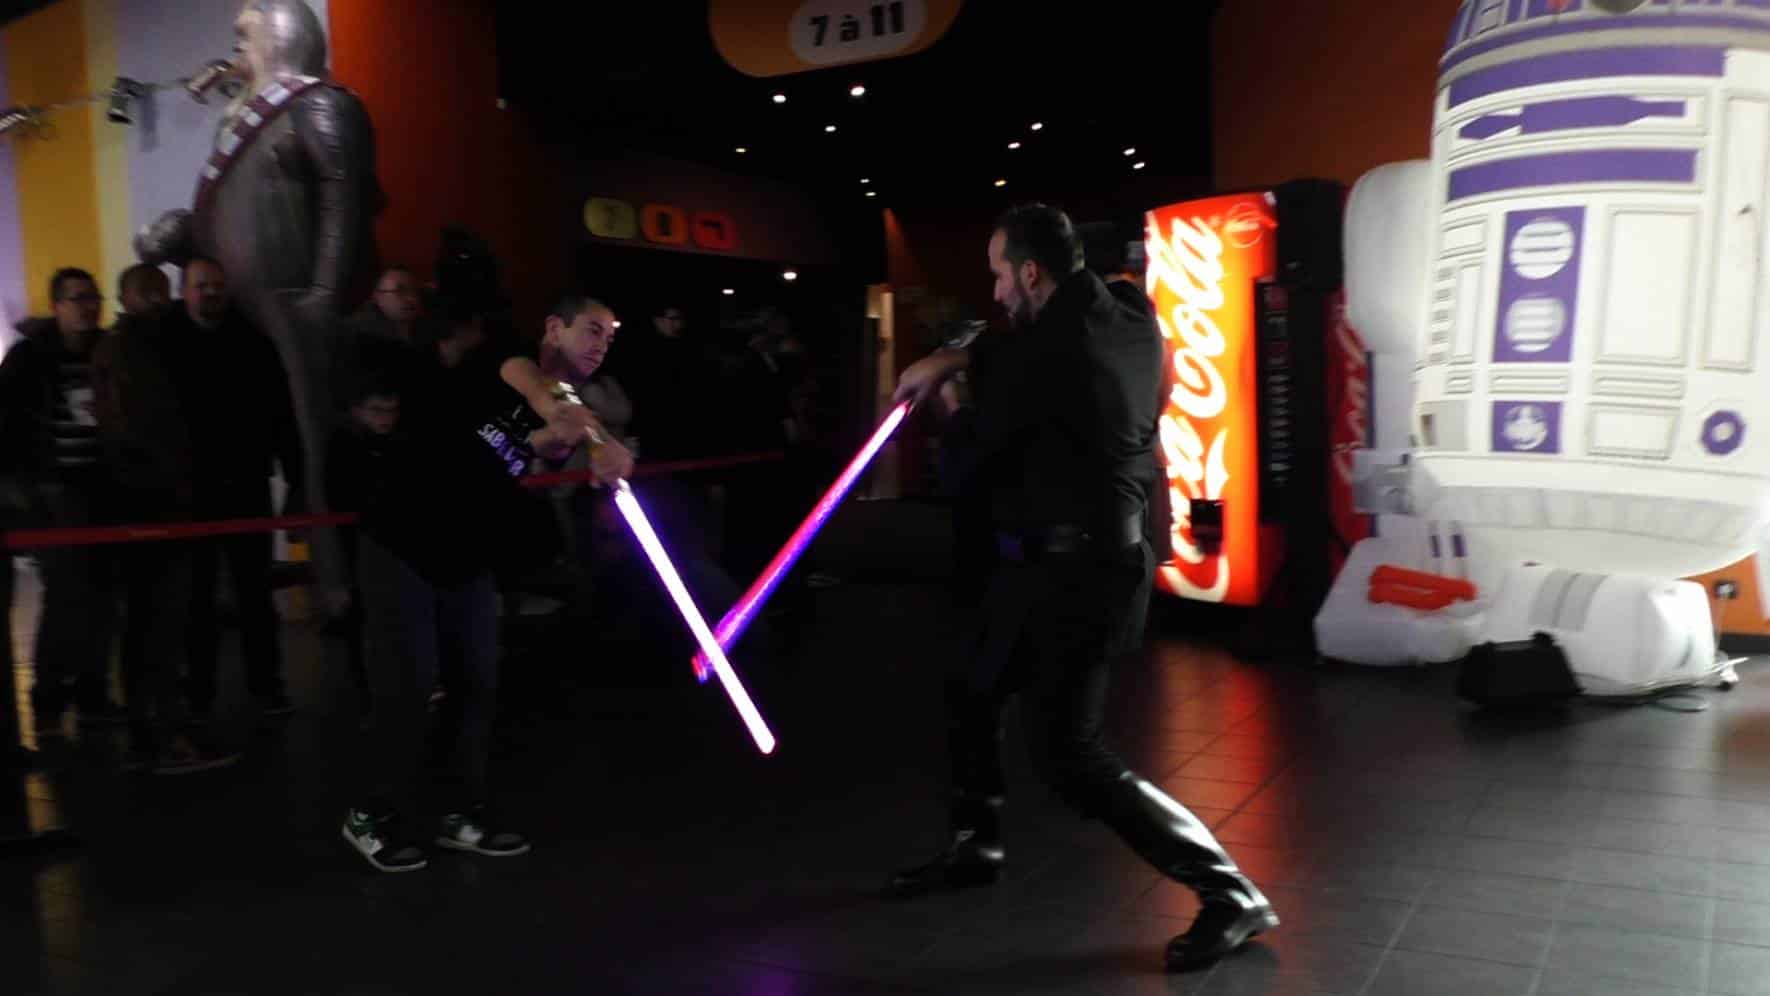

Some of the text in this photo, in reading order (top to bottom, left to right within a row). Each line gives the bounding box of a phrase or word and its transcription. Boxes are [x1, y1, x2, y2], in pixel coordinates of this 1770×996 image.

[808, 1, 905, 47] 7 à 11
